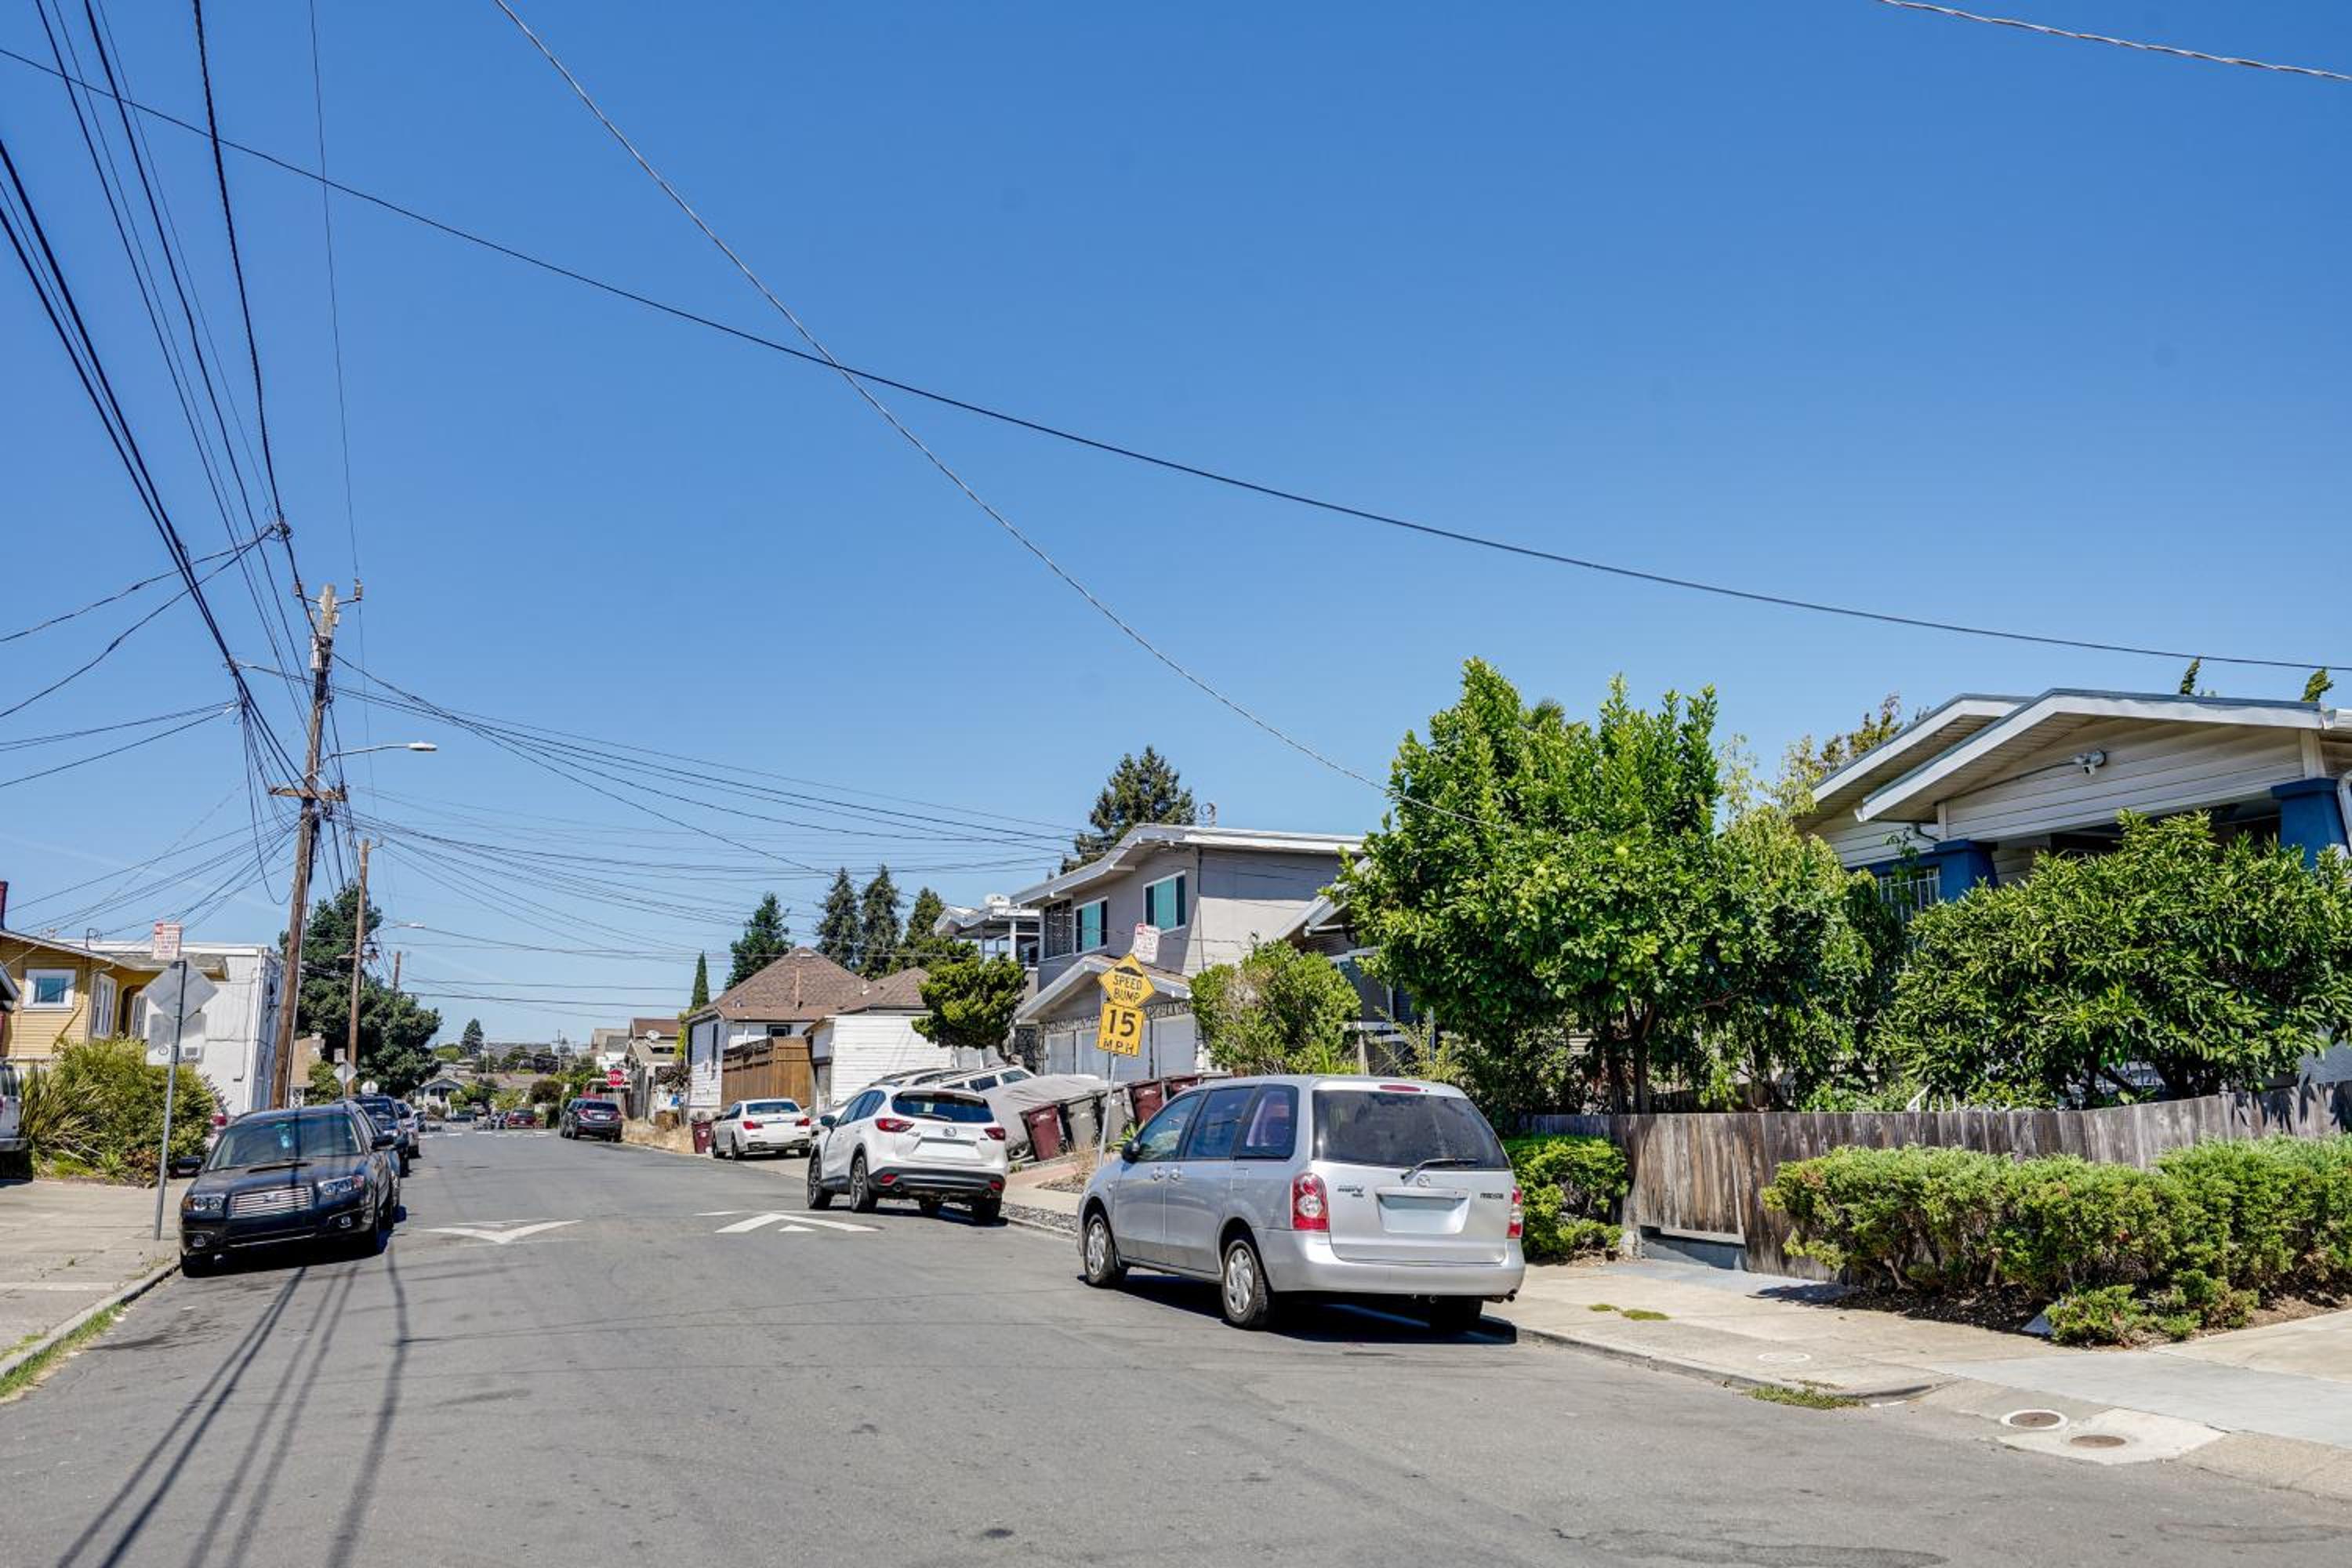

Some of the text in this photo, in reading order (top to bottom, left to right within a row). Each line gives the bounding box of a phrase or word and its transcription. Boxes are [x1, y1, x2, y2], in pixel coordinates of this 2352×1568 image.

[1112, 975, 1142, 991] SPEED
[1113, 987, 1141, 1004] BUMP
[1109, 1008, 1136, 1037] 15
[1103, 1037, 1134, 1054] MPH
